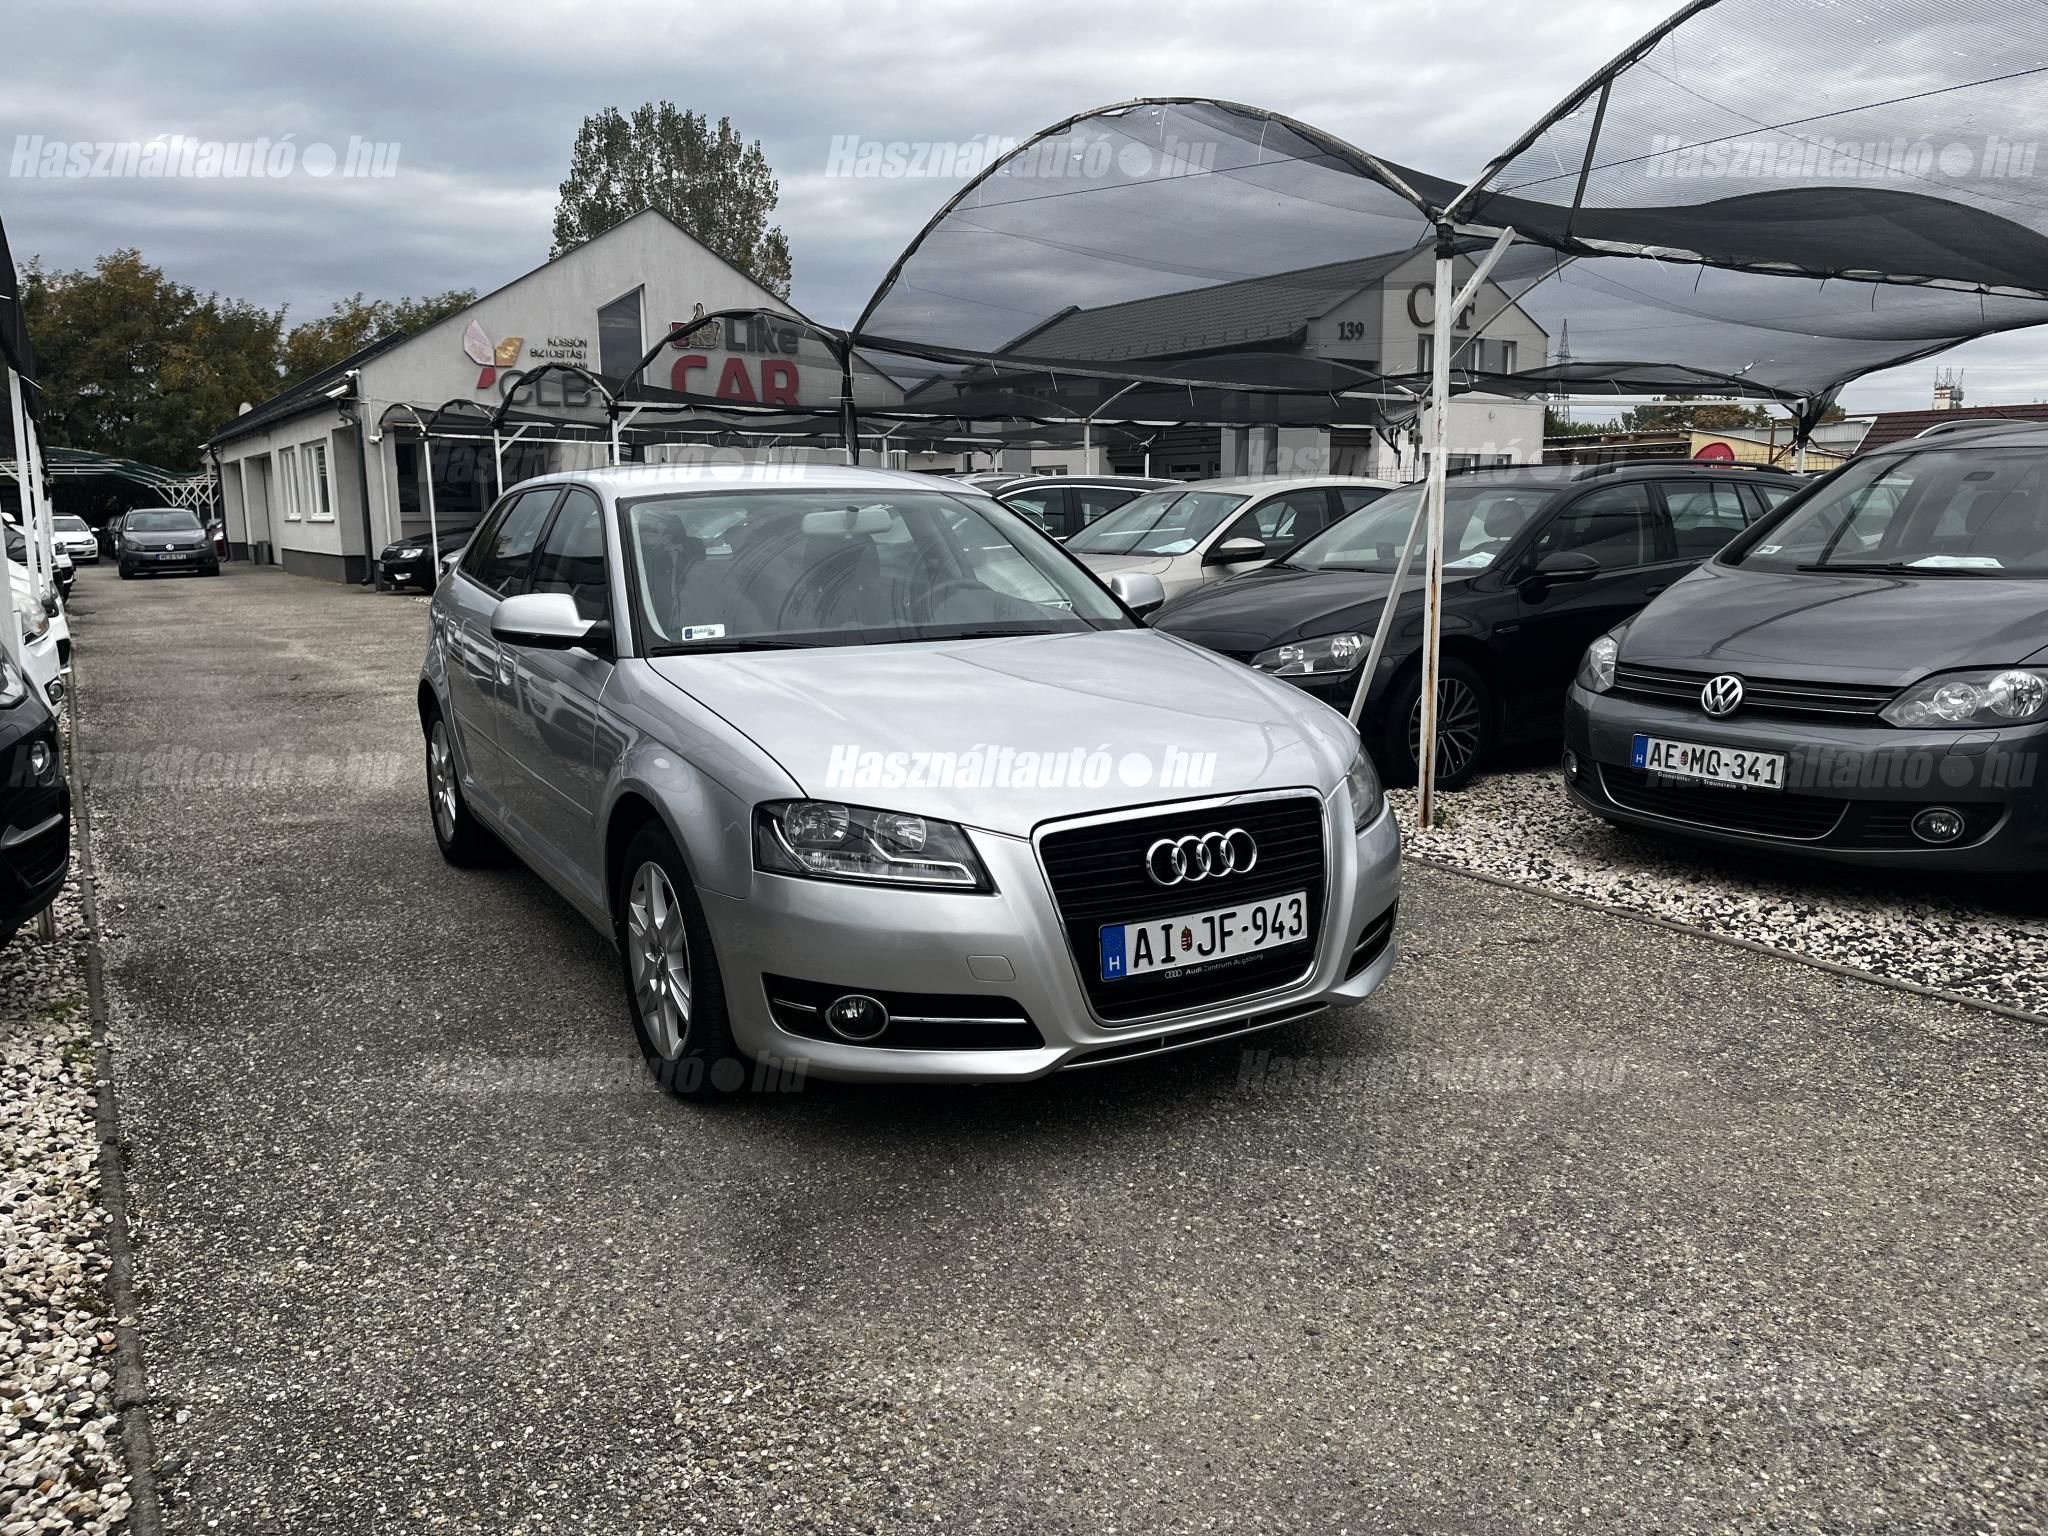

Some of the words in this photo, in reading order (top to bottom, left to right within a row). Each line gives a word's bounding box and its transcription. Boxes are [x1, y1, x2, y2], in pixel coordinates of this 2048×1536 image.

[1337, 321, 1364, 340] 139
[499, 370, 591, 406] CLB
[671, 355, 799, 406] CAR
[1636, 754, 1643, 764] H
[1649, 742, 1679, 770] AE
[1109, 956, 1120, 971] H
[1132, 923, 1176, 969] AI
[1197, 898, 1302, 957] JF-943
[1186, 966, 1202, 976] Audi
